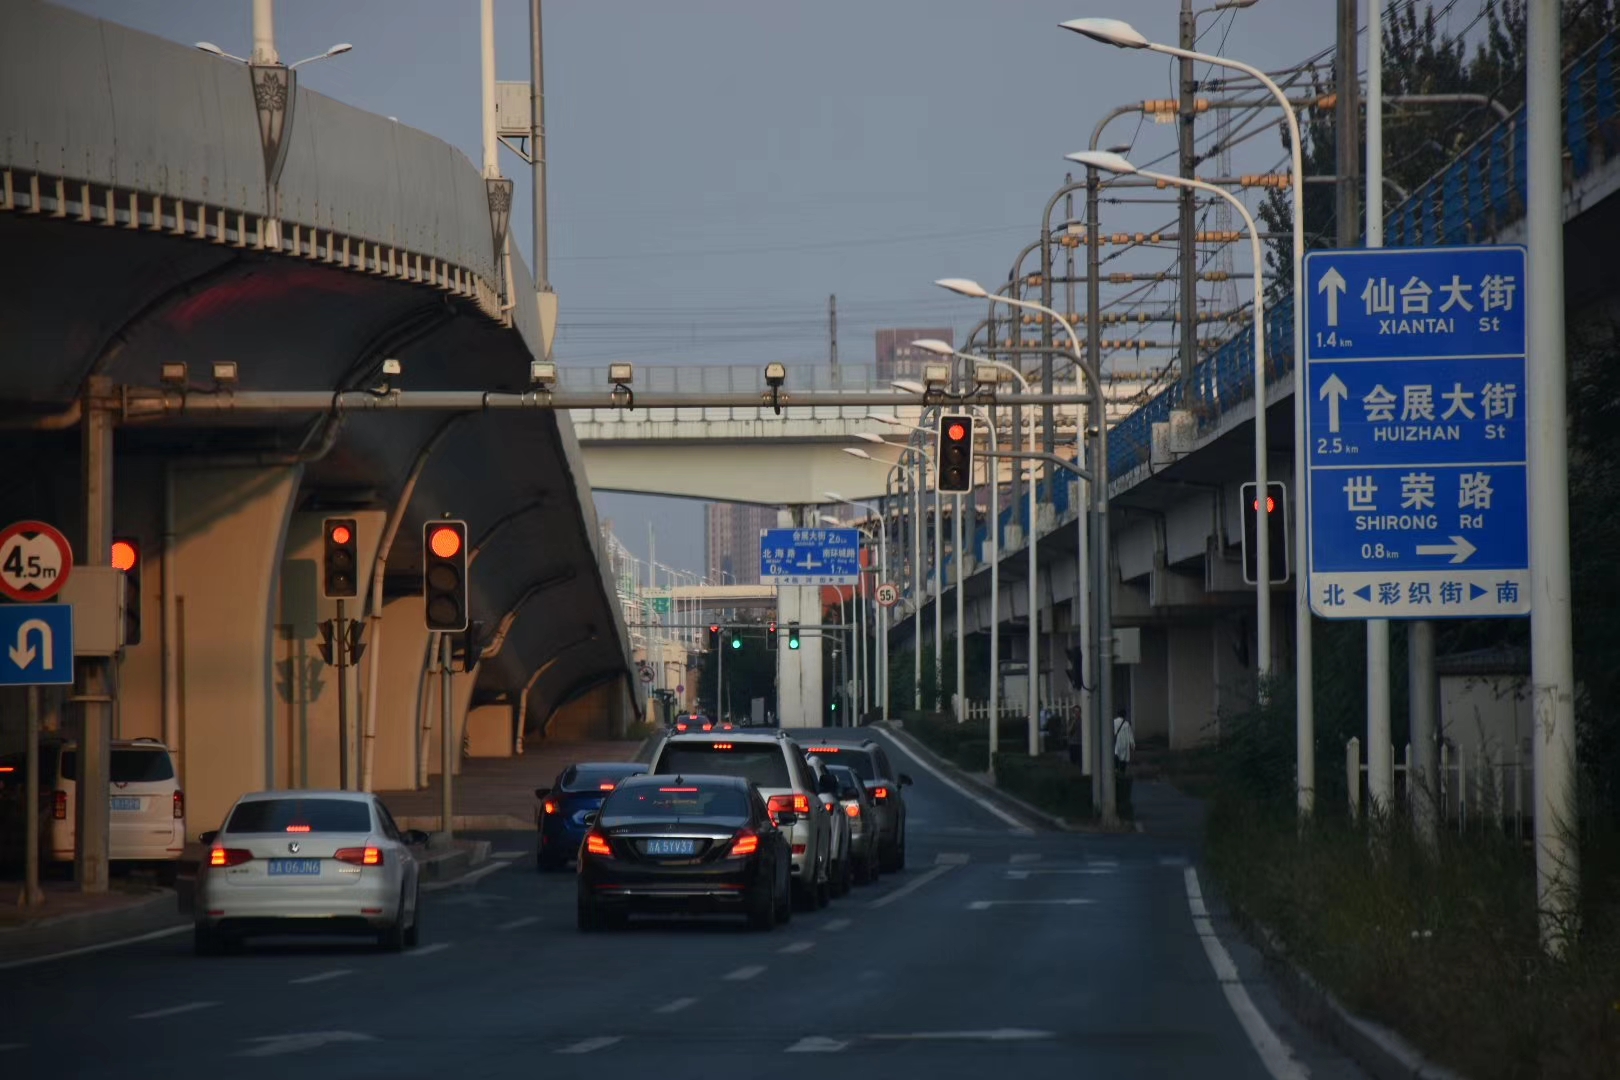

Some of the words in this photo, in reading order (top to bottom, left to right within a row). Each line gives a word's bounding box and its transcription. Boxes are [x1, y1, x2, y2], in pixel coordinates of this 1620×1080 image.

[1360, 275, 1516, 315] 仙台大街
[1379, 319, 1454, 335] XIANTAI
[1479, 317, 1500, 332] St
[1316, 332, 1337, 348] 1.4
[1340, 338, 1353, 347] km
[1362, 382, 1516, 422] 会展大街
[1374, 425, 1460, 441] HUIZHAN
[1485, 424, 1506, 439] St
[1317, 438, 1343, 454] 2.5
[1345, 445, 1359, 454] km
[1343, 472, 1494, 511] 世荣路
[1355, 515, 1438, 531] SHIRONG
[1459, 514, 1483, 529] Rd
[1361, 543, 1385, 559] 0.8
[1386, 550, 1399, 559] km
[3, 545, 57, 578] 4.5m
[1323, 583, 1345, 606] 北
[1378, 581, 1463, 605] 彩织街
[1496, 580, 1519, 604] 南
